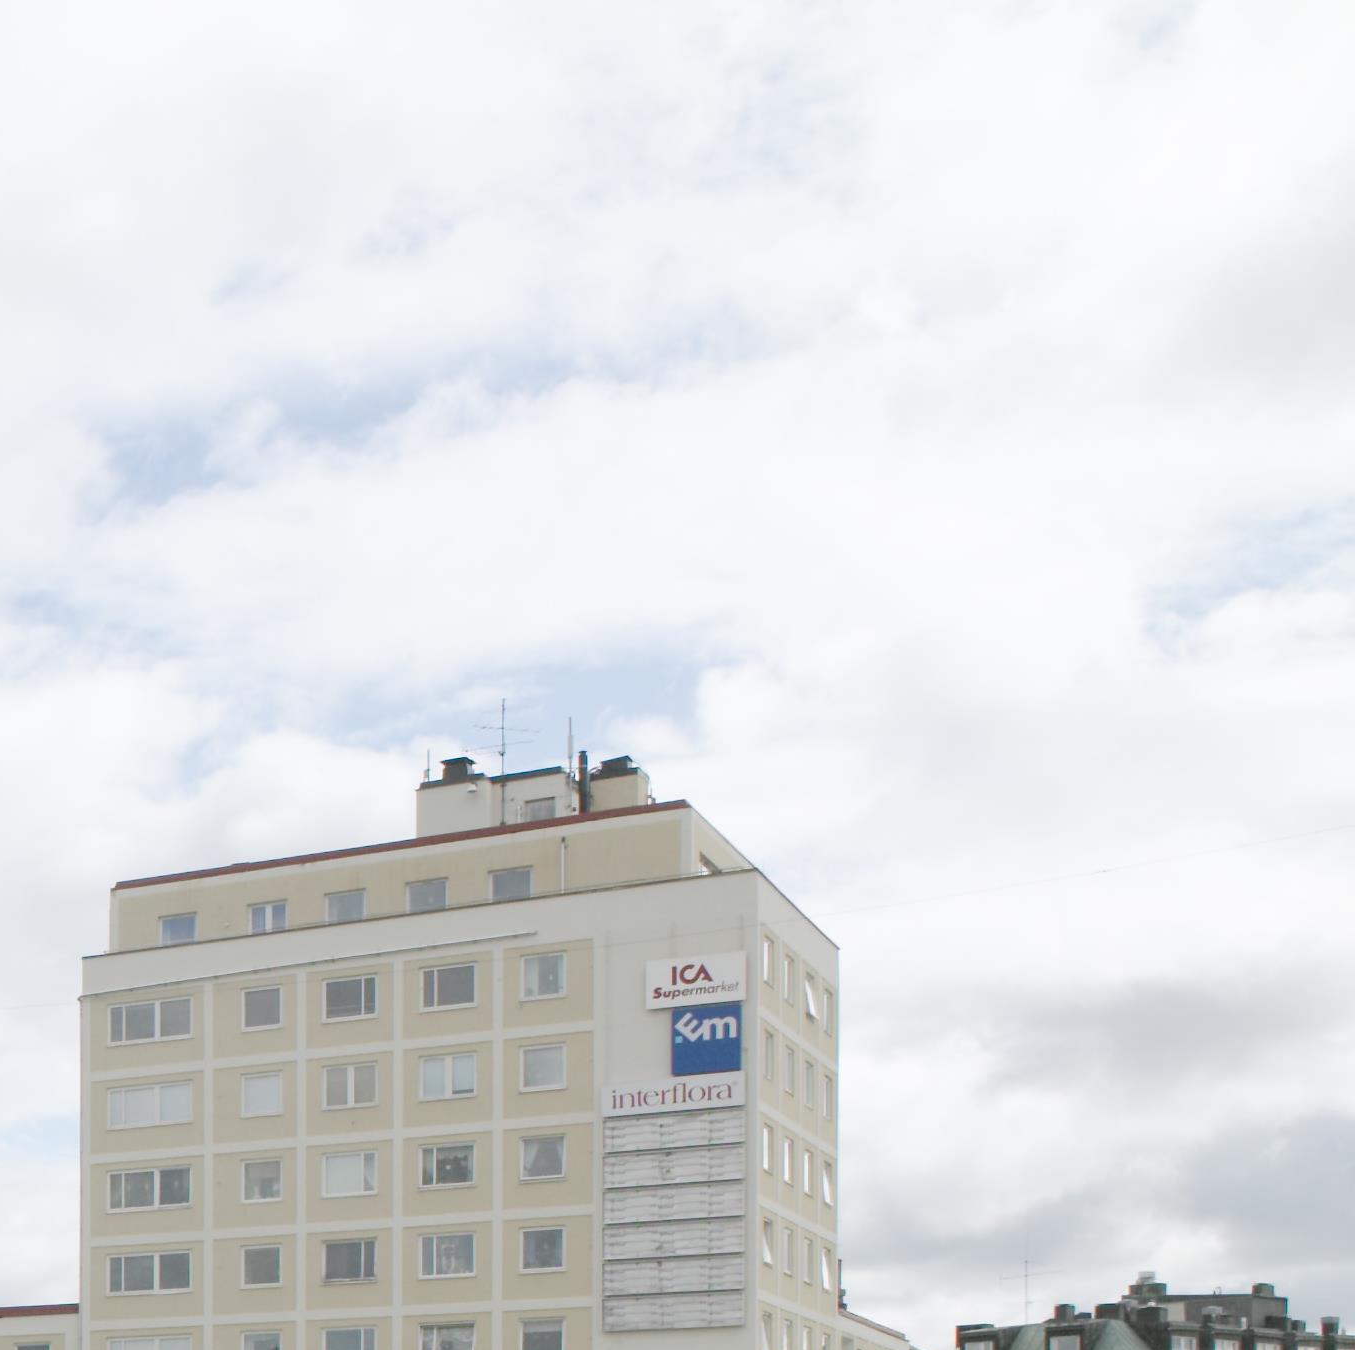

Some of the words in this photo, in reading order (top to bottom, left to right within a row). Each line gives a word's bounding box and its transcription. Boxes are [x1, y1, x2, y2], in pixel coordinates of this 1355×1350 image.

[671, 963, 713, 986] ICA
[653, 981, 739, 999] Supermarket
[612, 1082, 732, 1109] interflora
